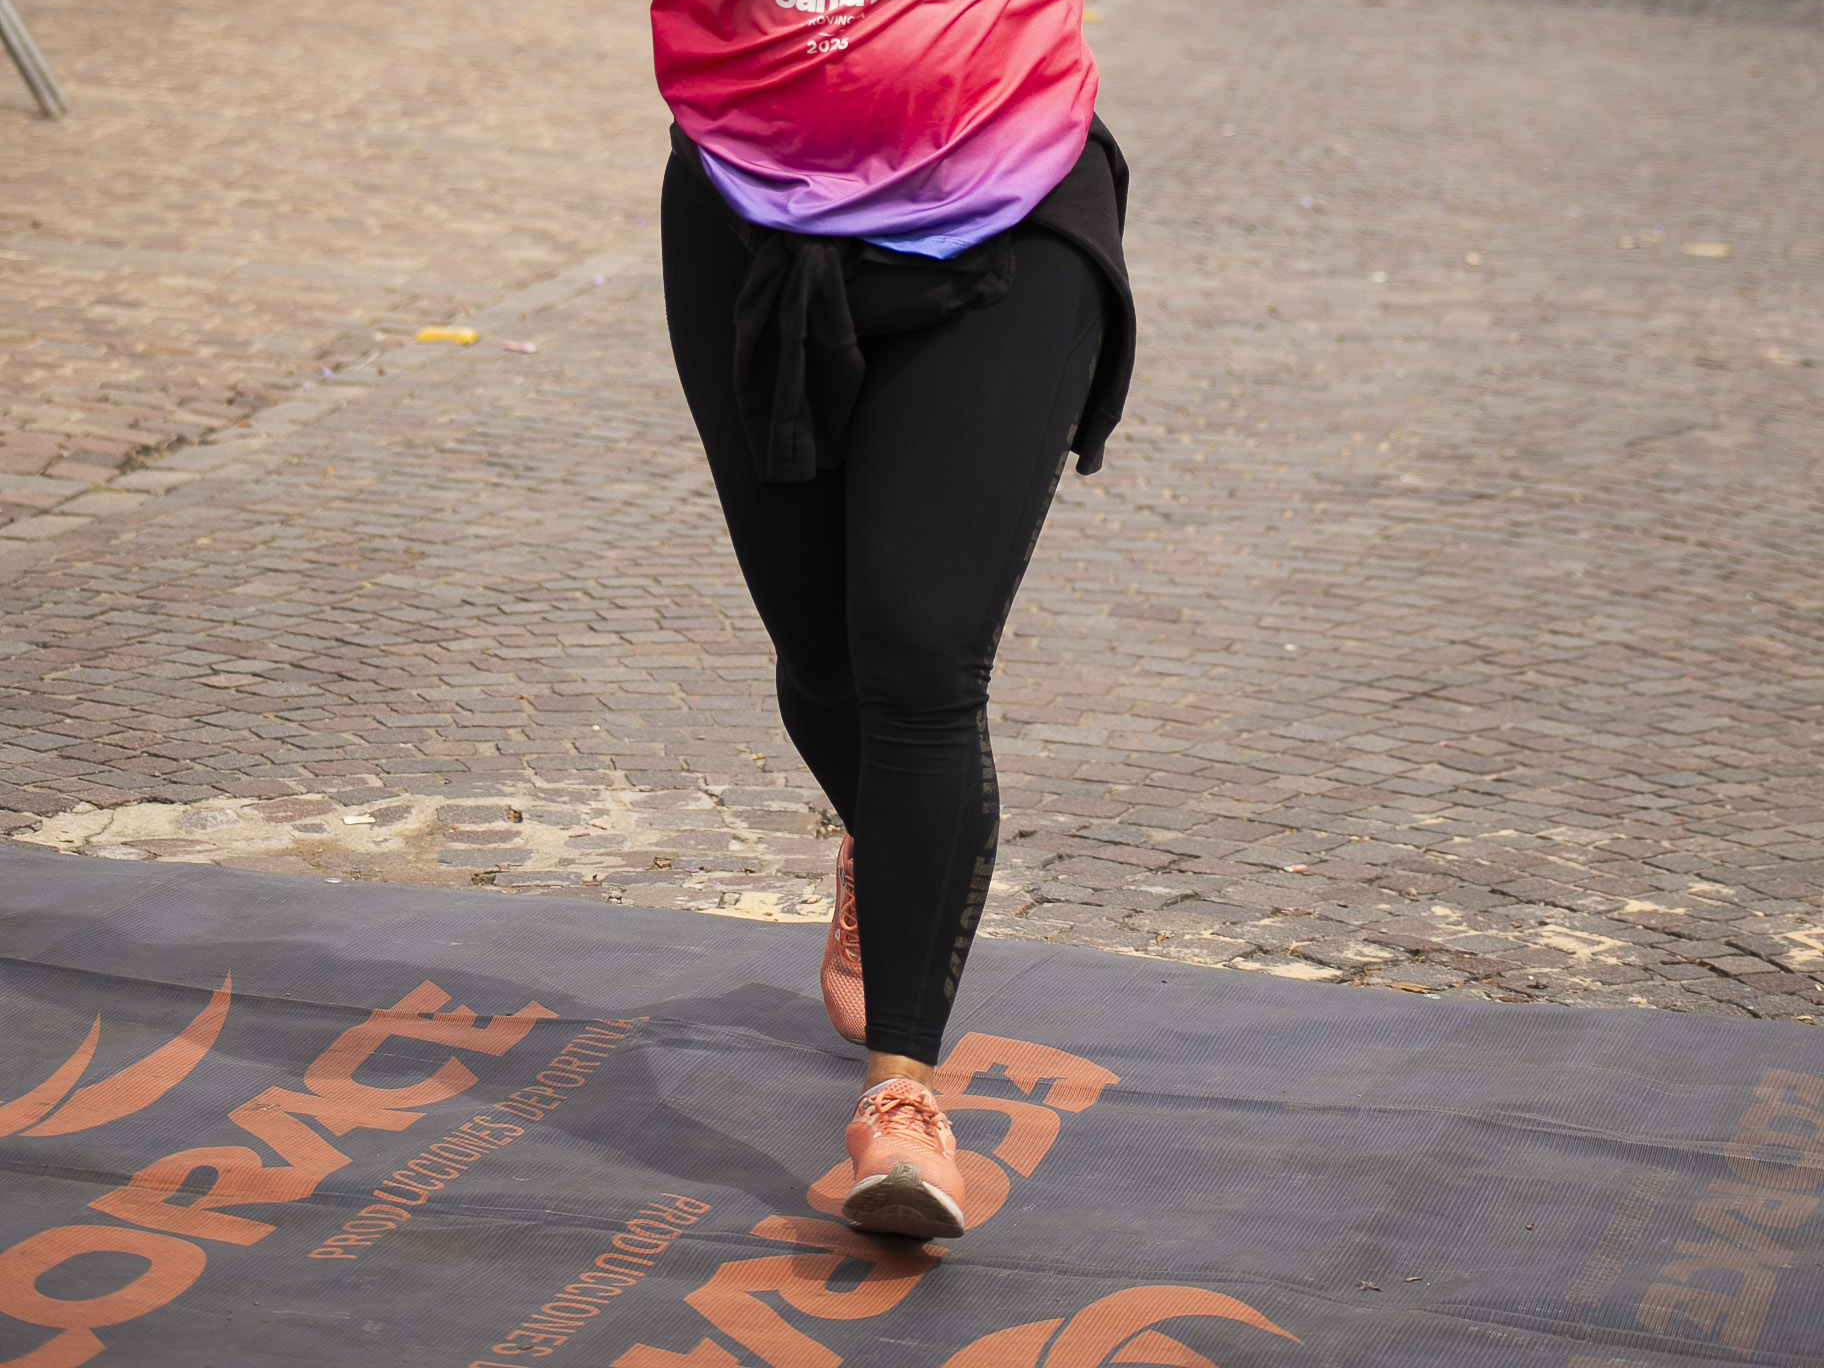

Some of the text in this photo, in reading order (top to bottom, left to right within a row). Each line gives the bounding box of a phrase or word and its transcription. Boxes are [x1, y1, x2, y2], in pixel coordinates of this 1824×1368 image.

[806, 36, 850, 55] 2025
[308, 1115, 525, 1260] PRODUCCIONES
[491, 1192, 712, 1358] PRODUCCIONES
